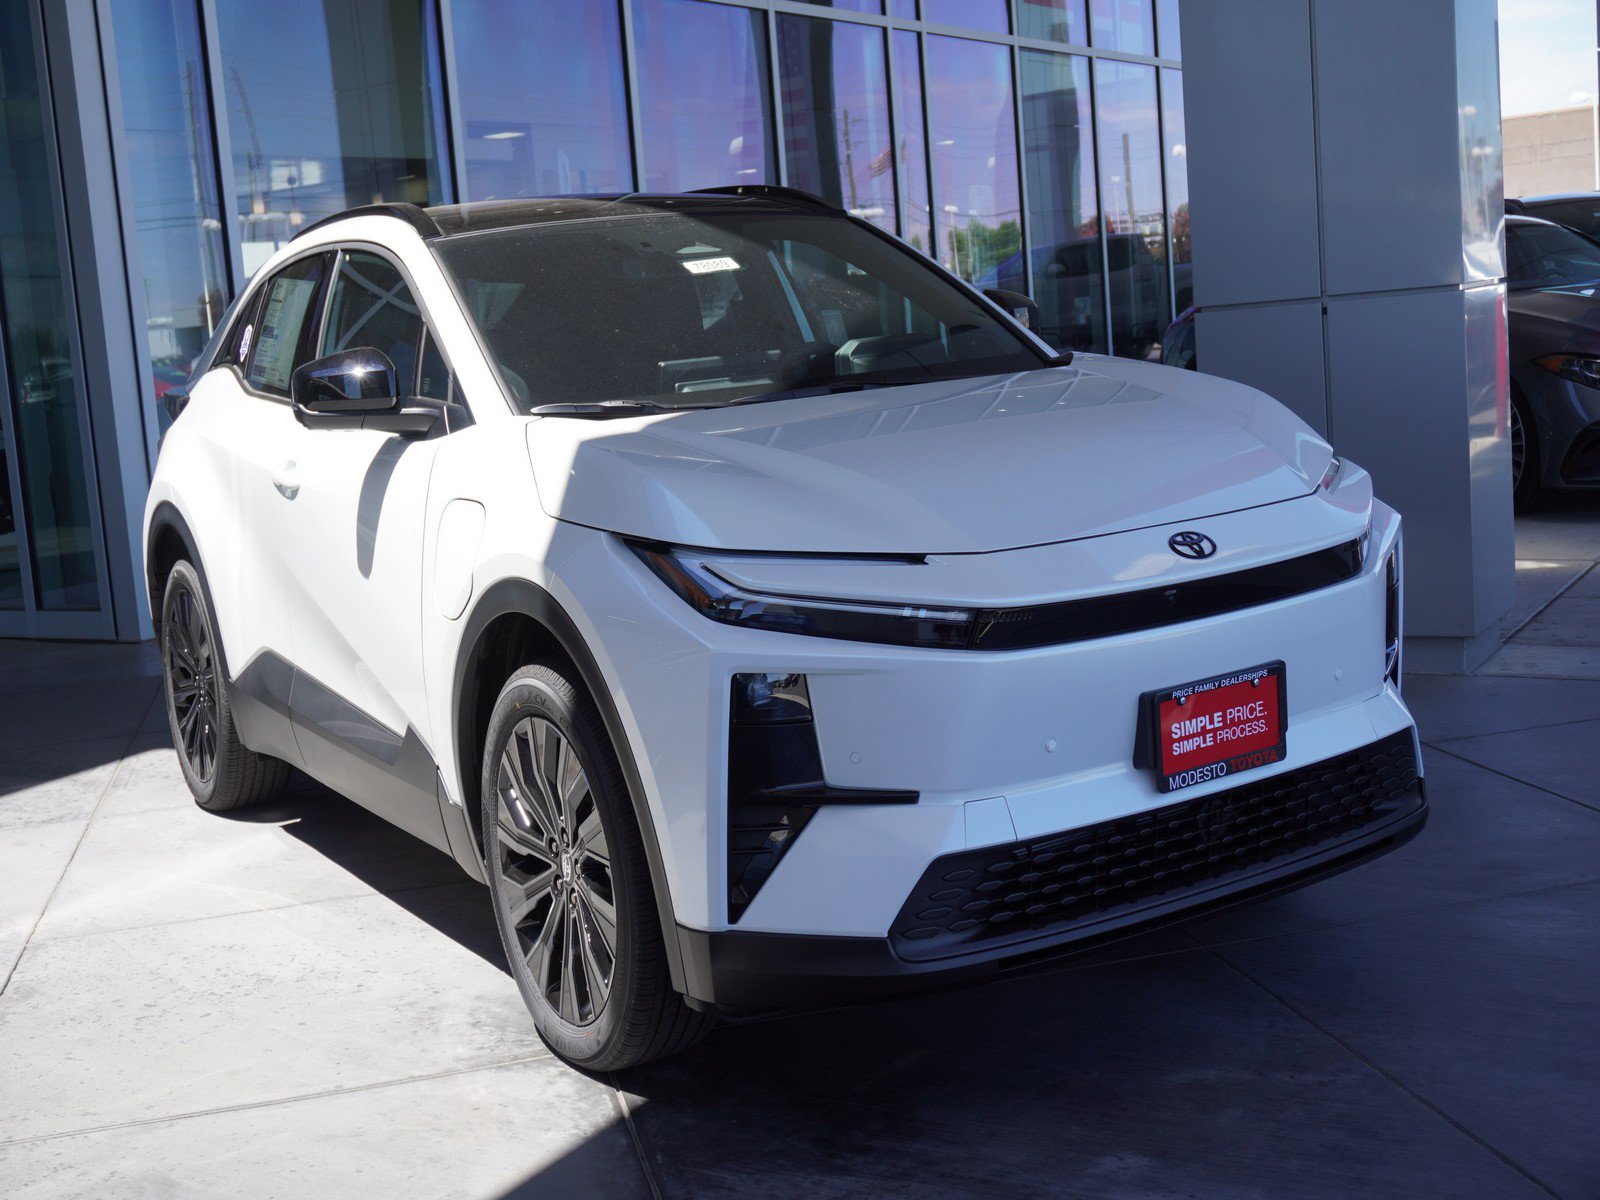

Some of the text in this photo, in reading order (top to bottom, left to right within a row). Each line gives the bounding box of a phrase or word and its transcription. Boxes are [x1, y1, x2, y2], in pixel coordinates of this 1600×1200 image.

[1172, 669, 1268, 699] PRICE FAMILY DEALERSHIPS
[1171, 701, 1268, 739] SIMPLE PRICE.
[1172, 720, 1269, 756] SIMPLE PROCESS.
[1169, 749, 1278, 791] MODESTO TOYOTA
